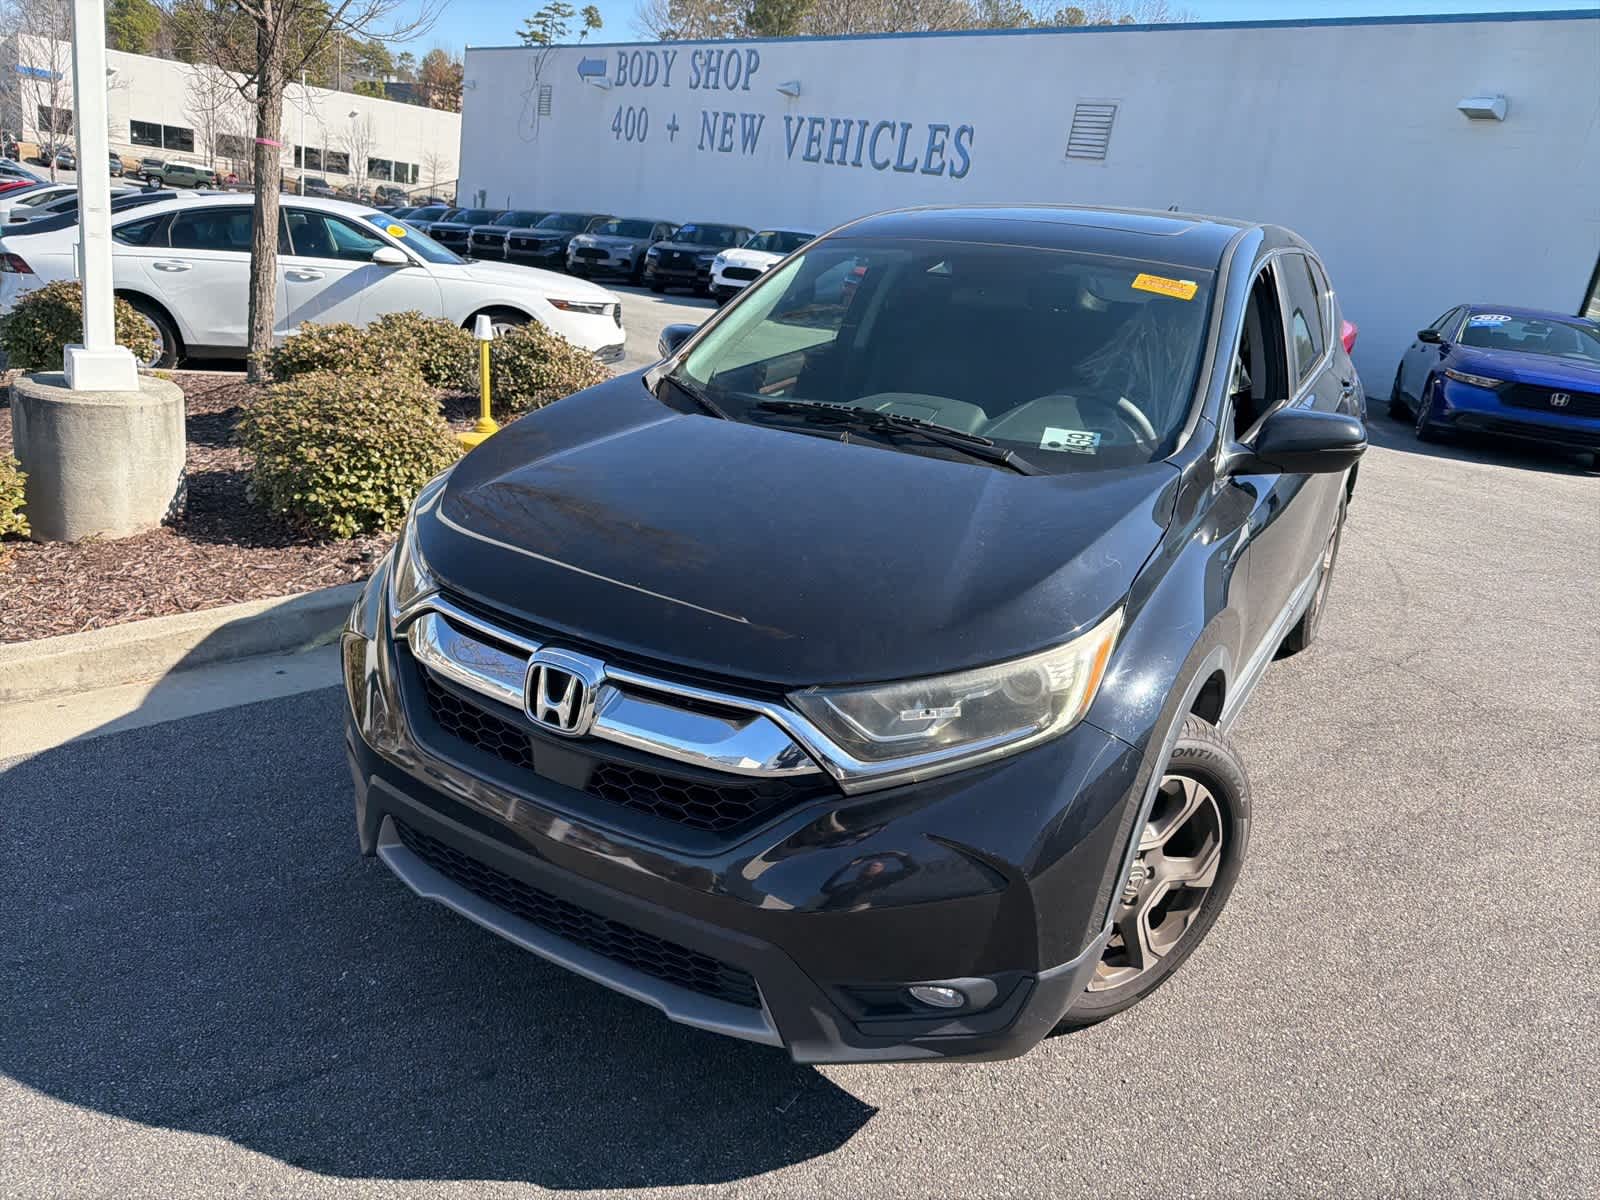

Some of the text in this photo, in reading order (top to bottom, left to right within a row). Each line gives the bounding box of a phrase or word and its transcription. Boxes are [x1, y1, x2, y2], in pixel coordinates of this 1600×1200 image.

[614, 48, 760, 91] BODY SHOP
[611, 104, 975, 180] 400 + NEW VEHICLES
